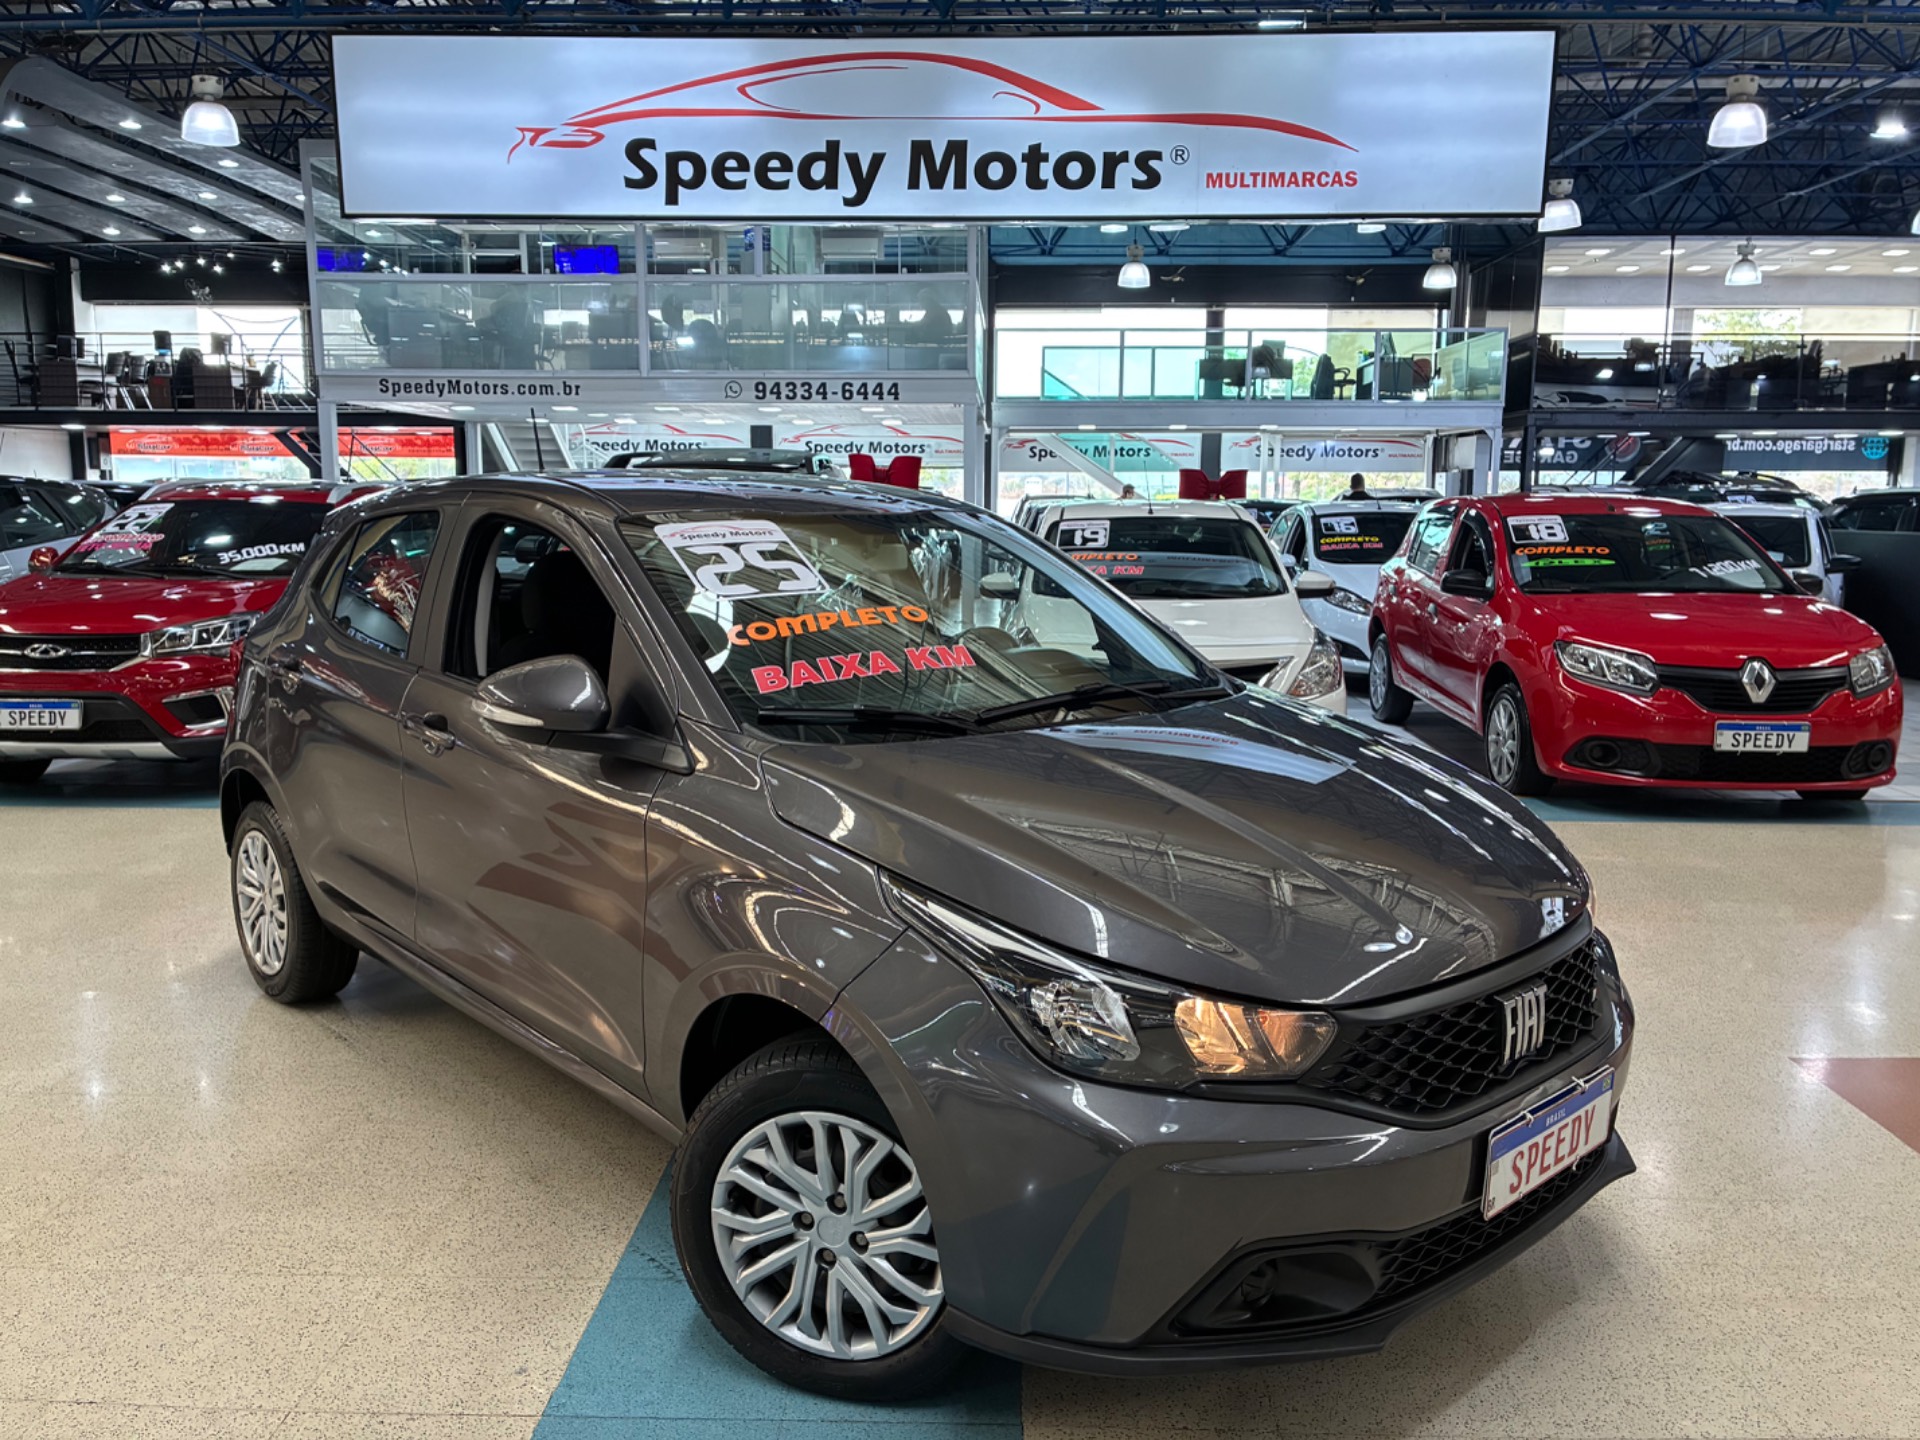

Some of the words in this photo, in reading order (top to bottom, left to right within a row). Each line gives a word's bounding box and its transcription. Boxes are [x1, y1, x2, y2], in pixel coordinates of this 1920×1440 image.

[624, 138, 886, 207] Speedy
[1206, 170, 1358, 189] MULTIMARCAS
[379, 378, 580, 397] SpeedyMotors.com.br
[754, 381, 900, 400] 94334-6444
[585, 439, 640, 454] peedy
[645, 440, 701, 451] Motors
[805, 441, 864, 454] Speedy
[868, 441, 926, 454] Motors
[1320, 445, 1379, 458] Motors
[679, 532, 727, 542] Speedy
[730, 529, 774, 538] Motors
[1074, 528, 1107, 546] 19
[1320, 536, 1379, 544] COMPLETO
[1528, 523, 1565, 541] 18
[1071, 553, 1138, 561] MPLETO
[1515, 546, 1610, 556] COMPLETO
[685, 543, 820, 596] 25
[1113, 566, 1144, 575] KM
[727, 604, 929, 645] COMPLETO
[751, 651, 902, 694] BAIXA
[905, 645, 977, 671] KM
[8, 710, 67, 726] SPEEDY
[1731, 732, 1796, 749] SPEEDY
[1503, 984, 1548, 1065] FIAT
[1545, 1108, 1567, 1127] BRASIL
[1509, 1104, 1597, 1194] SPEEDY
